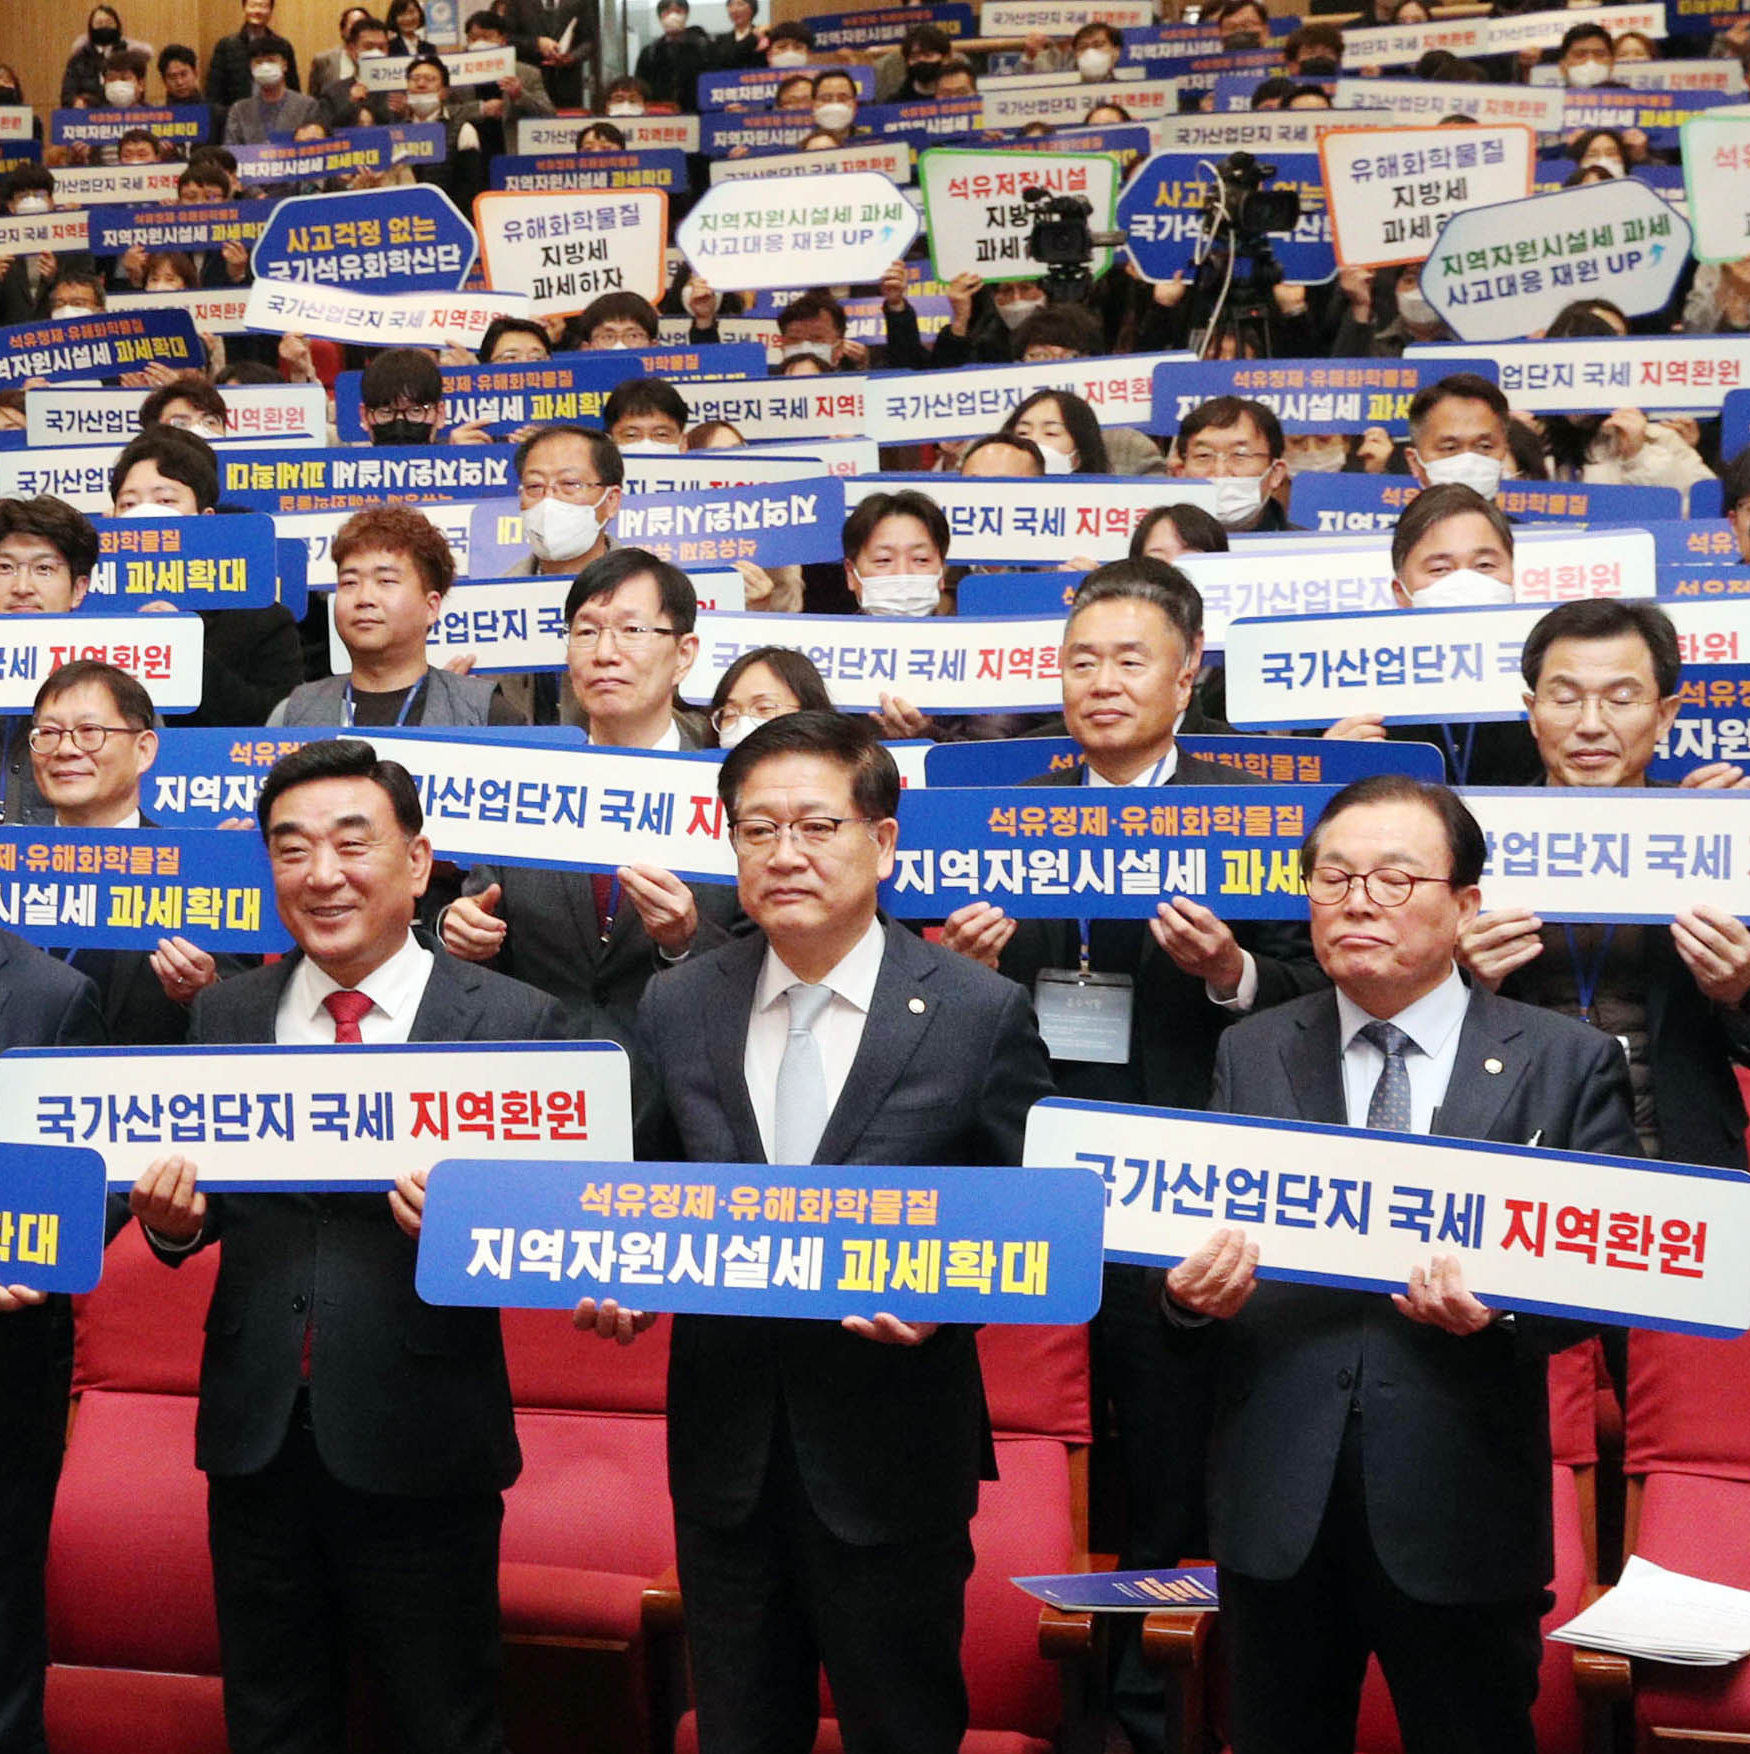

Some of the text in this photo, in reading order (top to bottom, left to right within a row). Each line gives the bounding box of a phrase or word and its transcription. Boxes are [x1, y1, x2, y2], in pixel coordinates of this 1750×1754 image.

[1350, 137, 1506, 183] 유해화학물질
[54, 174, 116, 194] 가산업단지
[1392, 177, 1469, 210] 지방세
[286, 214, 437, 254] 사고걱정 없는
[502, 202, 641, 244] 유해화학물질
[698, 202, 903, 233] 지역자원시설세 과세
[540, 238, 609, 268] 지방세
[842, 229, 875, 248] UP
[1441, 213, 1671, 278] 지역자원시설세 과세
[1606, 250, 1643, 275] UP
[532, 266, 624, 302] 과세하자
[116, 335, 189, 364] 과세확대
[1083, 377, 1153, 405] 지역환
[1502, 358, 1741, 390] 업단지 국세 지역환원
[45, 406, 142, 434] 국가산업단
[685, 395, 865, 424] 산업단지 국세 지역
[16, 467, 114, 495] 국가산업
[616, 494, 819, 540] 지역자원시설세
[1012, 506, 1066, 538] 국세
[124, 558, 248, 595] 과세확대
[1520, 561, 1622, 599] 역환원
[422, 606, 529, 645] 산업단지
[712, 641, 898, 682] 국업단지
[906, 649, 967, 681] 국세
[1261, 643, 1485, 689] 국가산업단지
[410, 772, 589, 831] 가산업단지
[599, 787, 676, 836] 국세
[986, 805, 1305, 838] 석유정제·유해화학물질
[892, 848, 1310, 897] 지역자원시설세 과세
[1483, 831, 1733, 881] 업단지 국세
[116, 884, 272, 932] 과세확대
[35, 1089, 589, 1143] 국가산업단지 국세 지역환원
[578, 1181, 941, 1227] 석유정제·유해화학물질
[1073, 1151, 1709, 1280] 국가산업단지 국세 지역환원
[465, 1228, 1051, 1297] 지역자원시설세 과세확대
